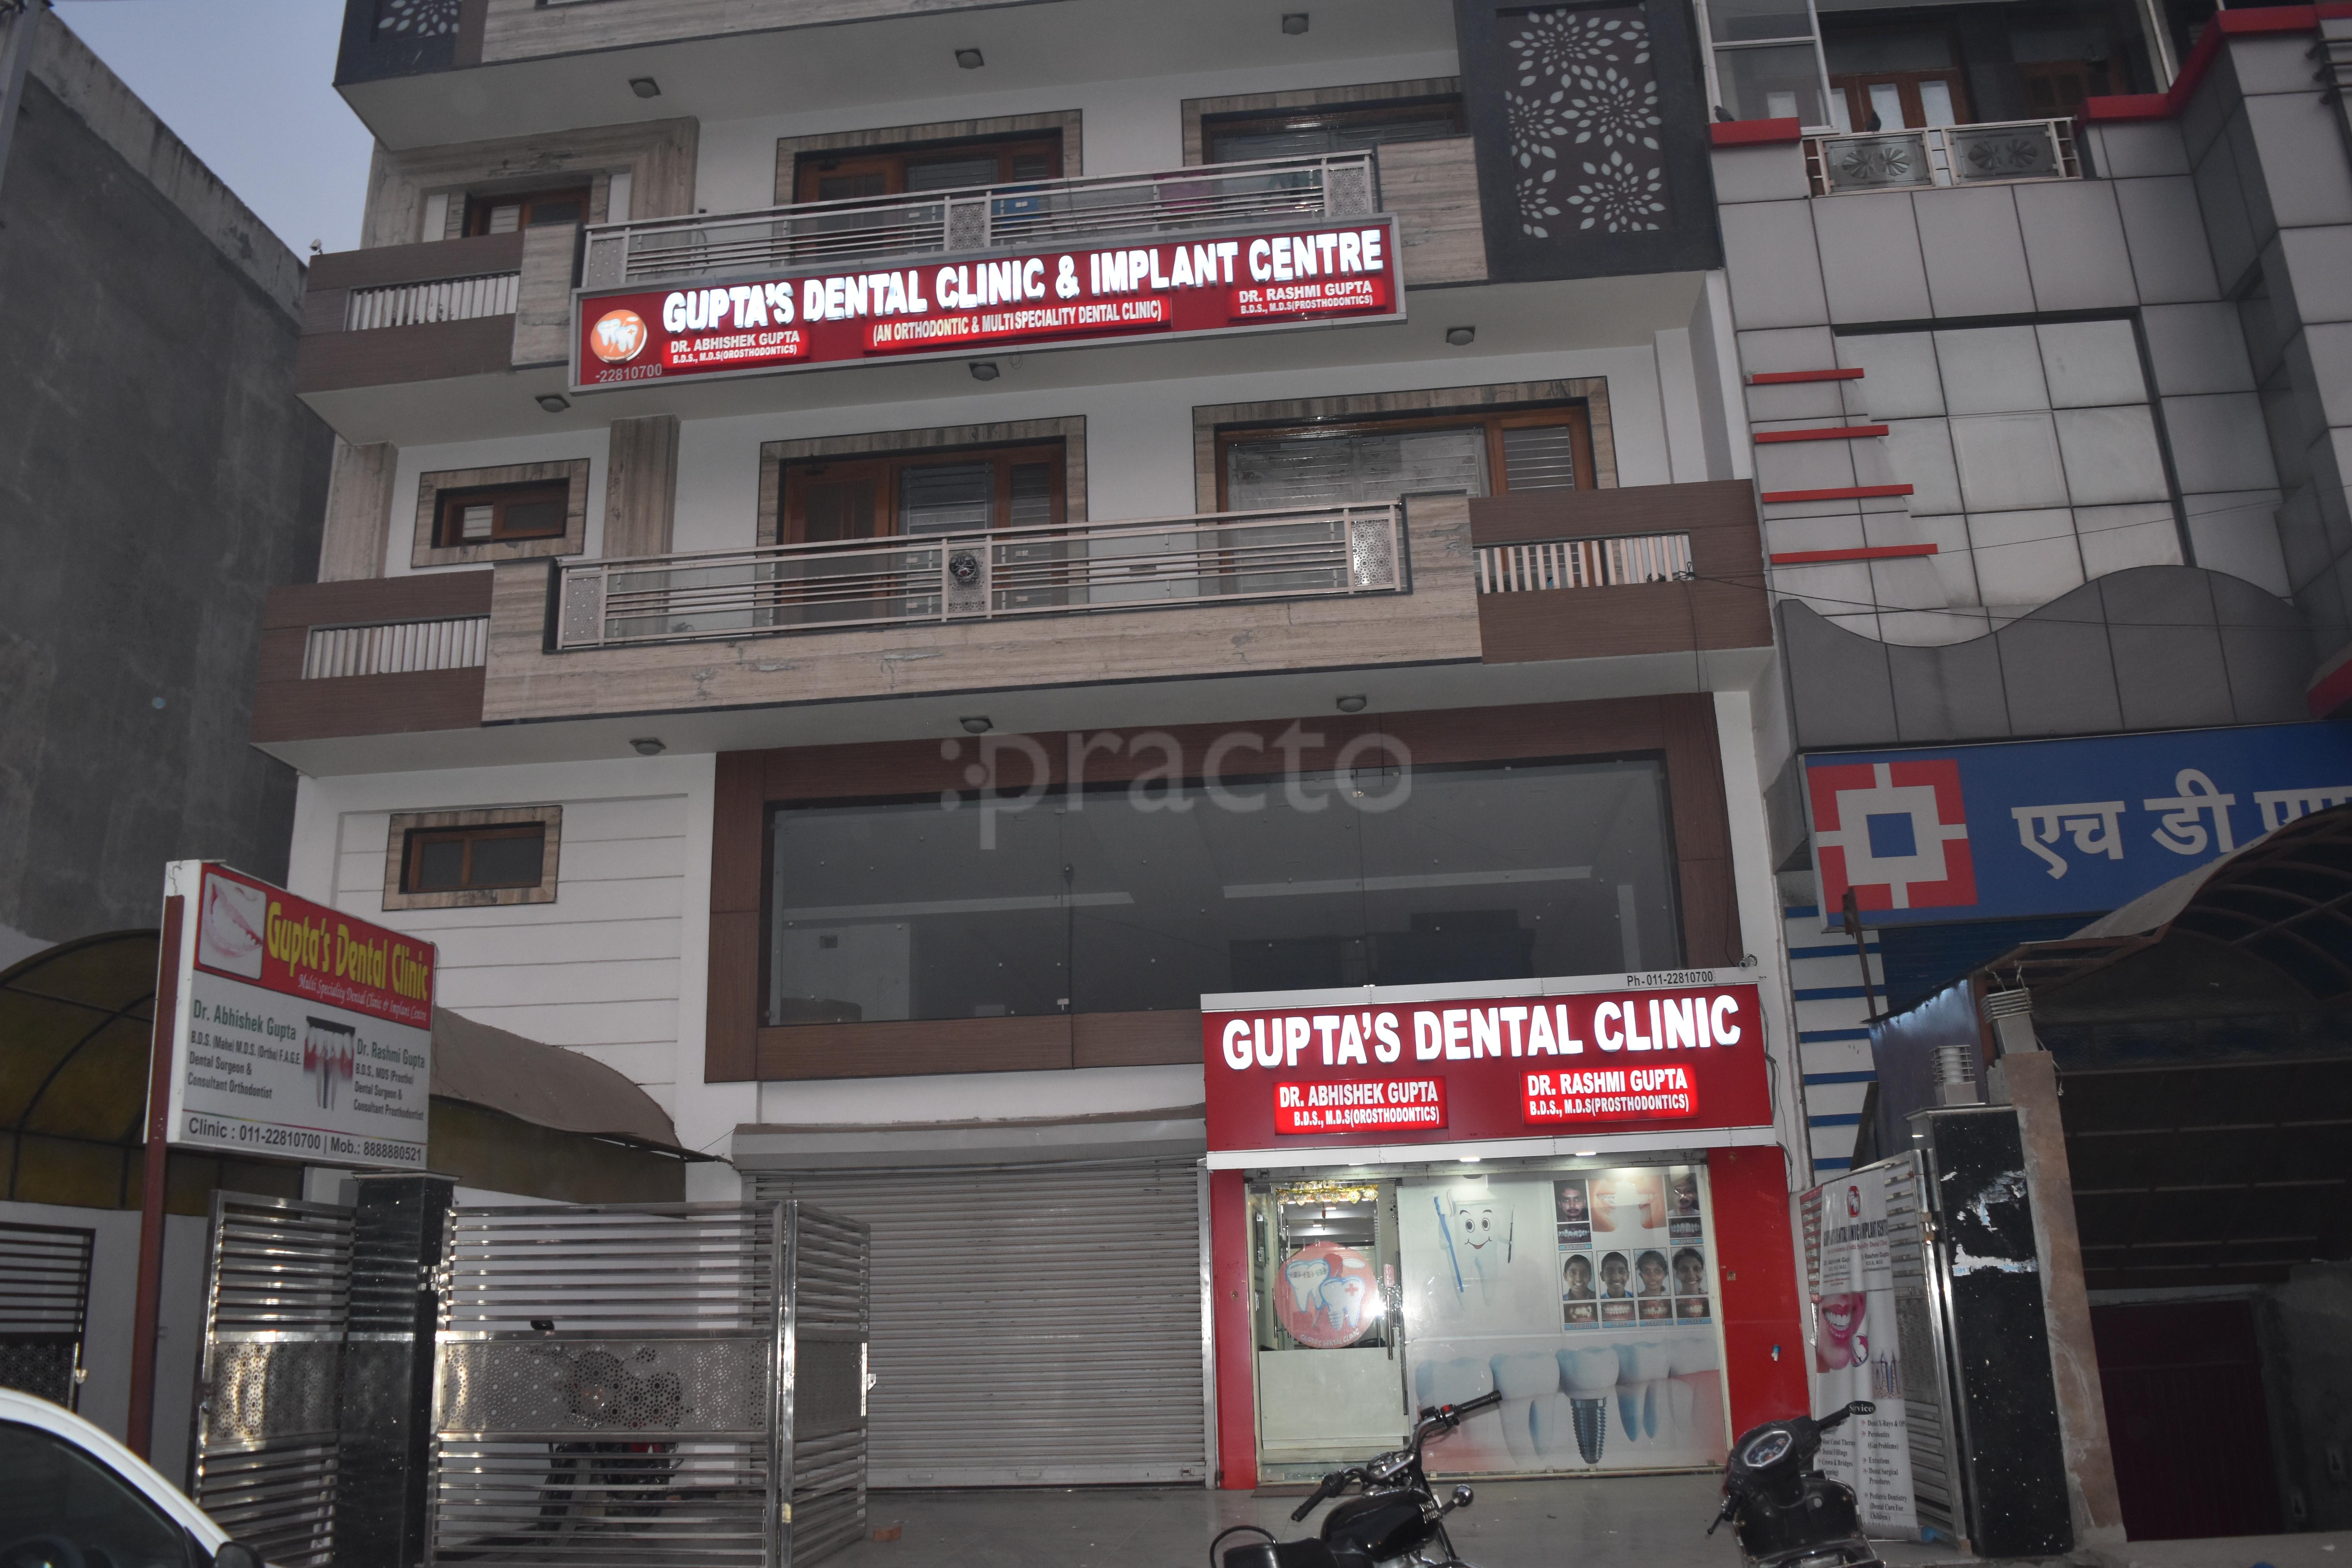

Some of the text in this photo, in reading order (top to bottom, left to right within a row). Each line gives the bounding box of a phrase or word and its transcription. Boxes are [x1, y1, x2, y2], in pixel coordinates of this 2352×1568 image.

[662, 229, 1384, 333] GUPTA'S DENTAL CLINIC & IMPLANT CENTRE
[1239, 281, 1373, 303] DR. RASHMI GUPTA
[1240, 304, 1268, 314] B.D.S.,
[873, 324, 892, 347] (AN
[894, 317, 969, 340] ORTHODONTIC
[971, 316, 979, 333] &
[1078, 304, 1120, 323] DENTAL
[1122, 299, 1161, 321] CLINIC)
[671, 330, 800, 353] DR. ABHISHEK GUPTA
[673, 354, 698, 364] B.D.S.,
[595, 364, 662, 383] -22810700
[2011, 800, 2126, 880] एच
[2143, 768, 2236, 855] डी
[267, 901, 428, 1001] Gupta's Dental Clinic
[299, 974, 317, 991] Multi
[317, 979, 345, 1003] Speciality
[347, 988, 366, 1004] Dental
[367, 993, 382, 1009] Clinic
[390, 1000, 410, 1018] Implant
[193, 999, 296, 1042] Dr. Abhishek Gupta
[1222, 995, 1741, 1071] GUPTA'S DENTAL CLINIC
[191, 1030, 211, 1047] B.D.S.
[236, 1040, 256, 1056] M.D.S.
[258, 1045, 278, 1062] (Ortho)
[357, 1038, 425, 1071] Dr. Rashmi Gupta
[189, 1051, 252, 1075] Dental Surgeon &
[188, 1072, 272, 1099] Consultant Orthodontist
[376, 1067, 389, 1080] MDS
[390, 1070, 414, 1085] (Prostho)
[1527, 1068, 1688, 1096] DR. RASHMI GUPTA
[355, 1081, 402, 1100] Dental Surgeon &
[1279, 1081, 1438, 1108] DR. ABHISHEK GUPTA
[354, 1098, 423, 1120] Consultant Prosthodontist
[1294, 1111, 1324, 1129] B.D.S.,
[1530, 1100, 1562, 1118] B.D.S.,
[189, 1117, 227, 1138] Clinic
[240, 1125, 321, 1149] 011-22810700
[330, 1137, 360, 1154] Mob.:
[363, 1142, 421, 1162] 8888880521
[1838, 1459, 1853, 1467] Bridges
[1887, 1494, 1907, 1503] Dentistry
